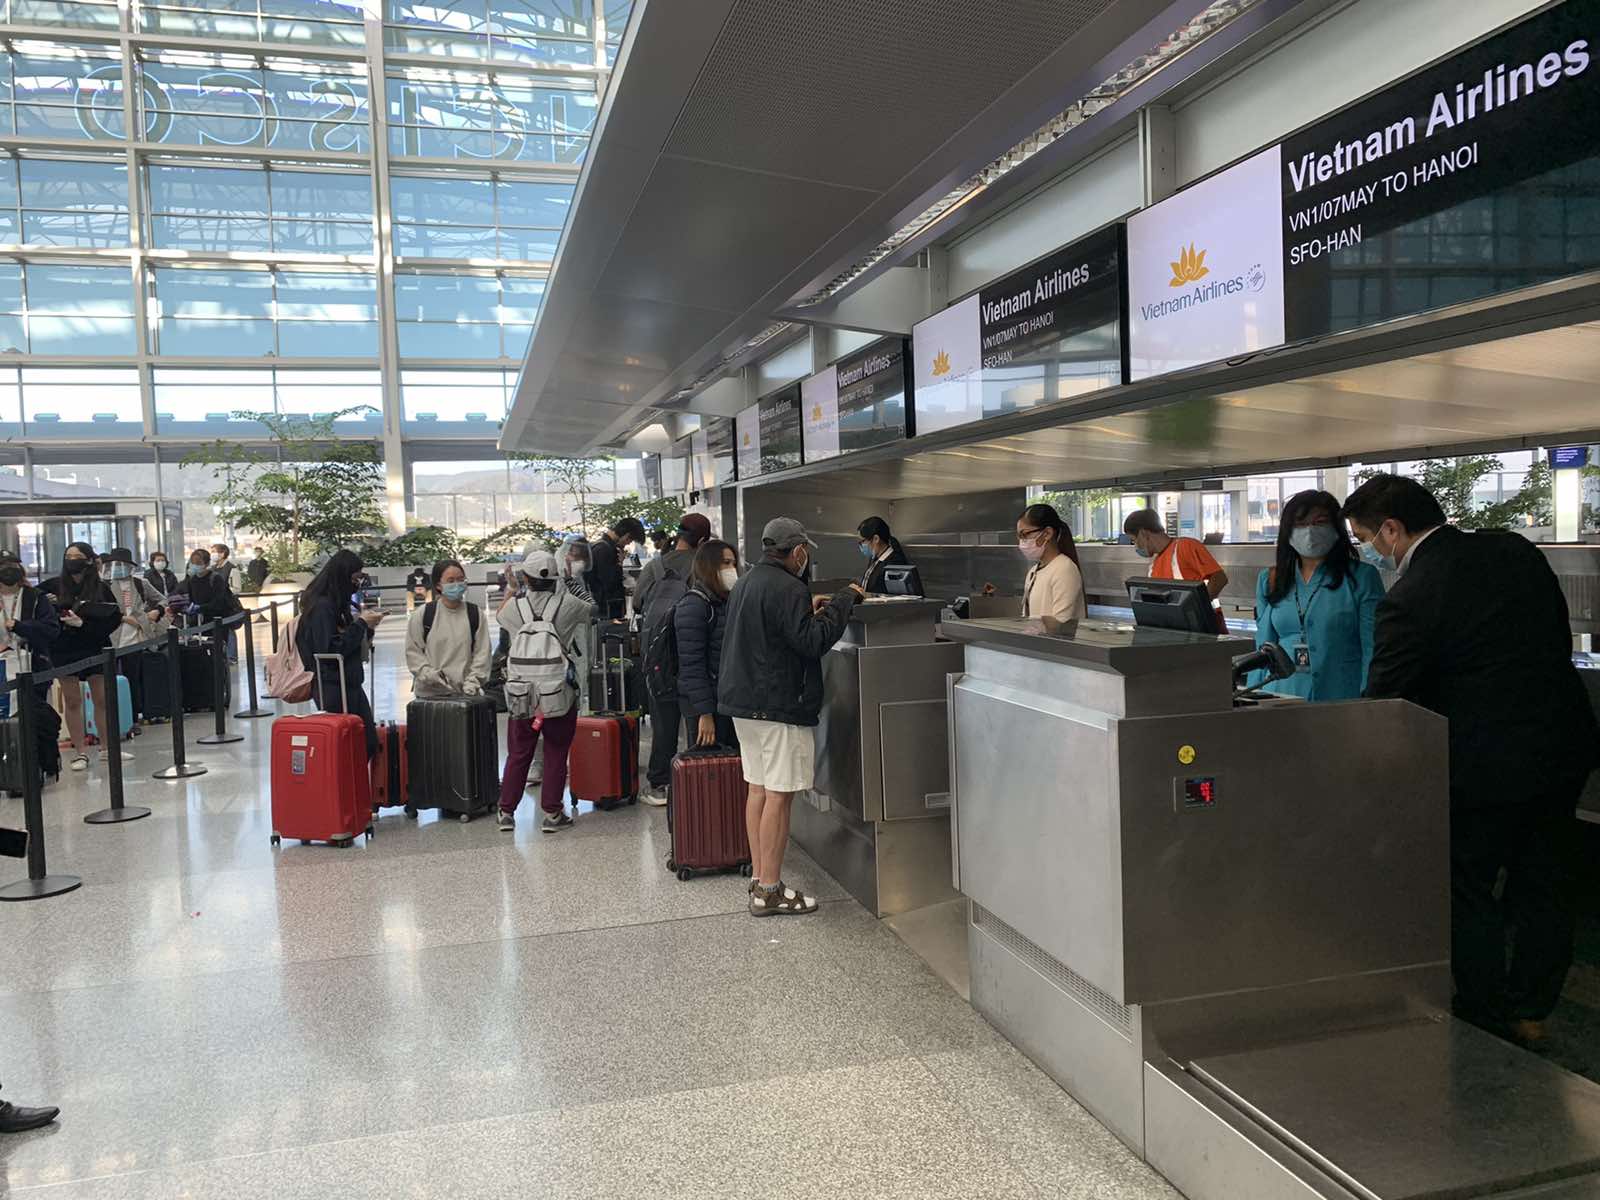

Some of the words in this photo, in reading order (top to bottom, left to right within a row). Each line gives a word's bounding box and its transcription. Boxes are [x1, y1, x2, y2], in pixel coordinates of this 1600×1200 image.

[1288, 116, 1415, 192] Vietnam
[1425, 39, 1590, 138] Airlines
[1289, 181, 1378, 233] VN1/07MAY
[1381, 171, 1408, 197] TO
[1413, 142, 1478, 187] HANOI
[1289, 224, 1362, 266] SFO-HAN
[982, 289, 1031, 326] Vietnam
[1034, 263, 1090, 304] Airlines
[1019, 320, 1029, 336] TO
[1030, 311, 1055, 333] HANOI
